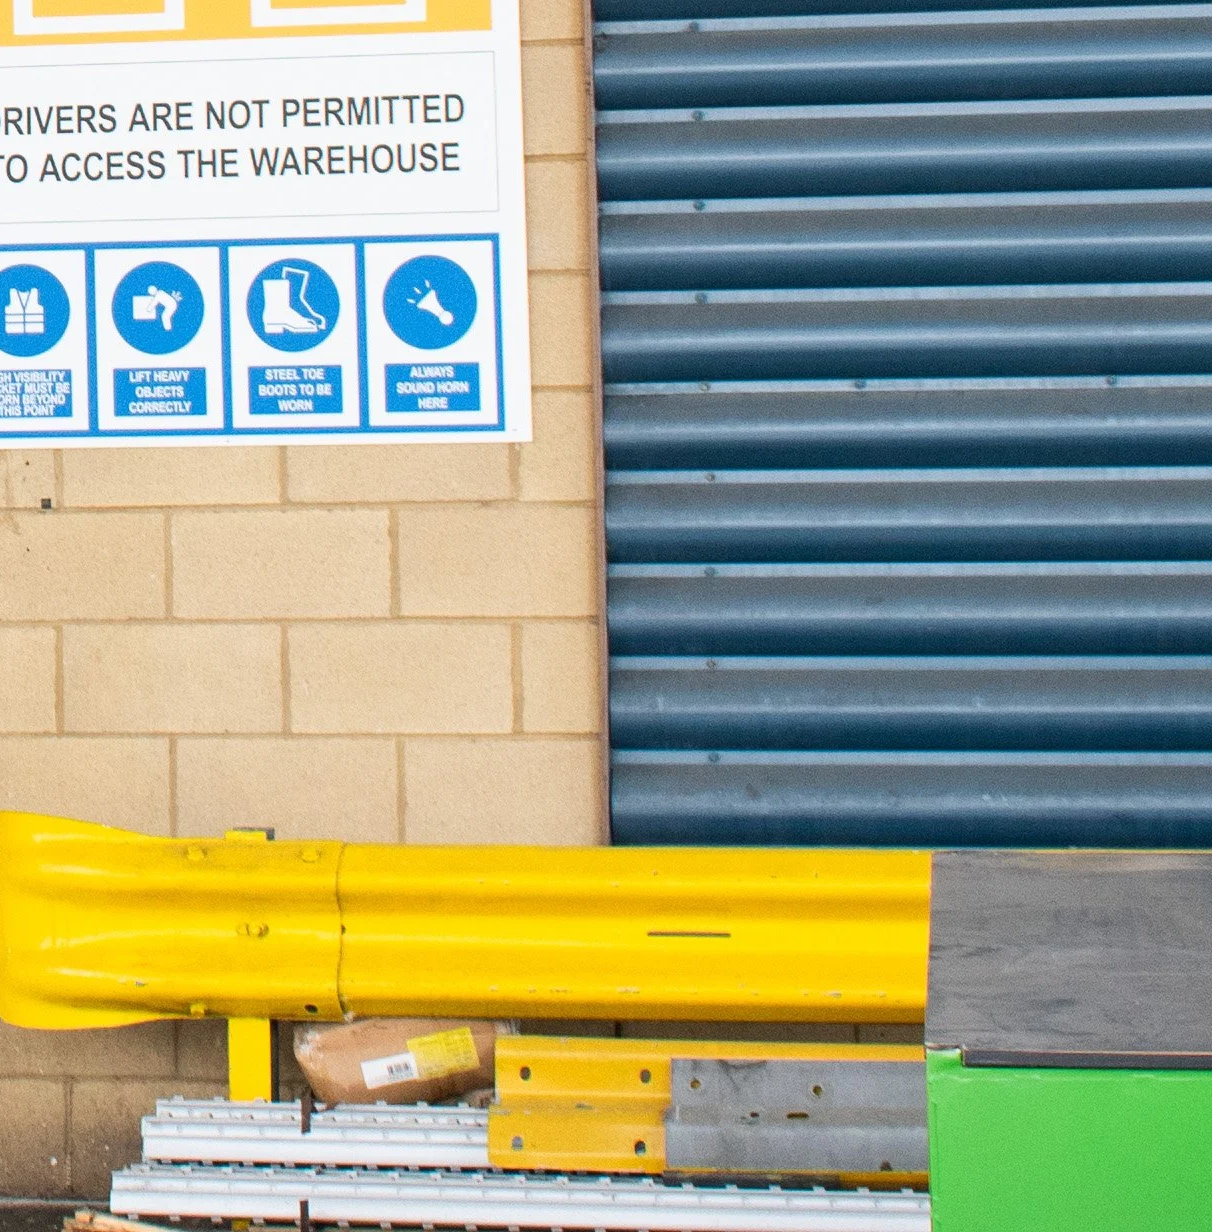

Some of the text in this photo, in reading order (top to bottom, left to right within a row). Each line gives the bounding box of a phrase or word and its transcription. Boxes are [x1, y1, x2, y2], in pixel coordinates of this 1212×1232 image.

[128, 102, 193, 132] ARE
[206, 99, 270, 130] NOT
[282, 94, 464, 128] PERMITTED
[39, 150, 166, 182] ACCESS
[177, 148, 239, 178] THE
[250, 142, 460, 177] WAREHOUSE
[14, 371, 65, 383] VISIBILITY
[128, 370, 189, 383] LIFT HEAVY
[265, 368, 325, 381] STEEL TOE
[410, 366, 454, 378] ALWAYS
[24, 383, 53, 394] MUST
[56, 382, 70, 393] BE
[135, 386, 184, 398] OBJECTS
[258, 383, 332, 396] BOOTS TO BE
[396, 381, 470, 394] SOUND HORN
[23, 394, 65, 406] BEYOND
[278, 400, 313, 412] WORN
[418, 397, 449, 409] HERE
[0, 405, 55, 416] THIS POINT
[128, 401, 191, 414] CORRECTLY
